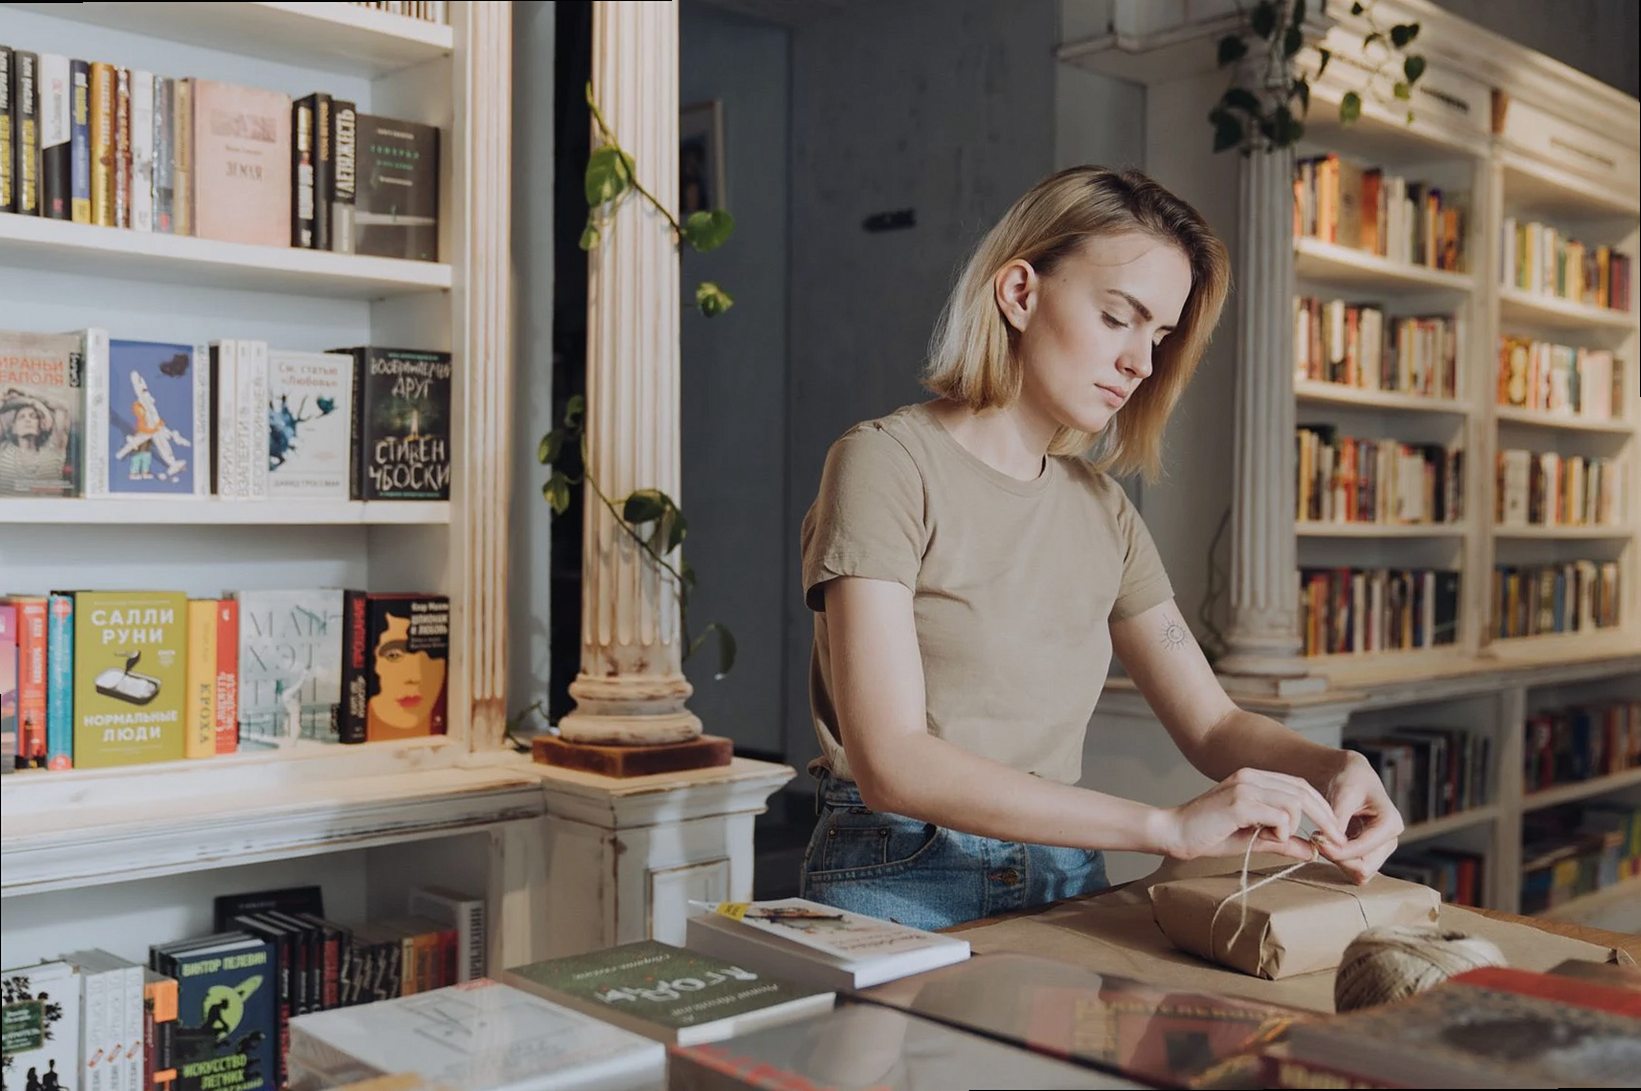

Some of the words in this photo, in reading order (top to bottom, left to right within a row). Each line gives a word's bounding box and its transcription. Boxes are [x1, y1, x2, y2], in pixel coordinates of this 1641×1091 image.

[391, 376, 433, 400] ДРУГ
[375, 436, 445, 465] СТИВЕН
[368, 462, 451, 491] ЧБОСКИ
[90, 608, 175, 626] САЛЛИ
[102, 627, 164, 645] РУНИ
[83, 709, 178, 727] НОРМАЛЬНЫЕ
[200, 683, 212, 743] КРОХА
[102, 726, 161, 743] ЛЮДИ
[182, 958, 222, 977] ВИКТОР
[222, 951, 267, 971] ПЕЛЕВИН
[183, 1053, 247, 1078] ИСКУССТВО
